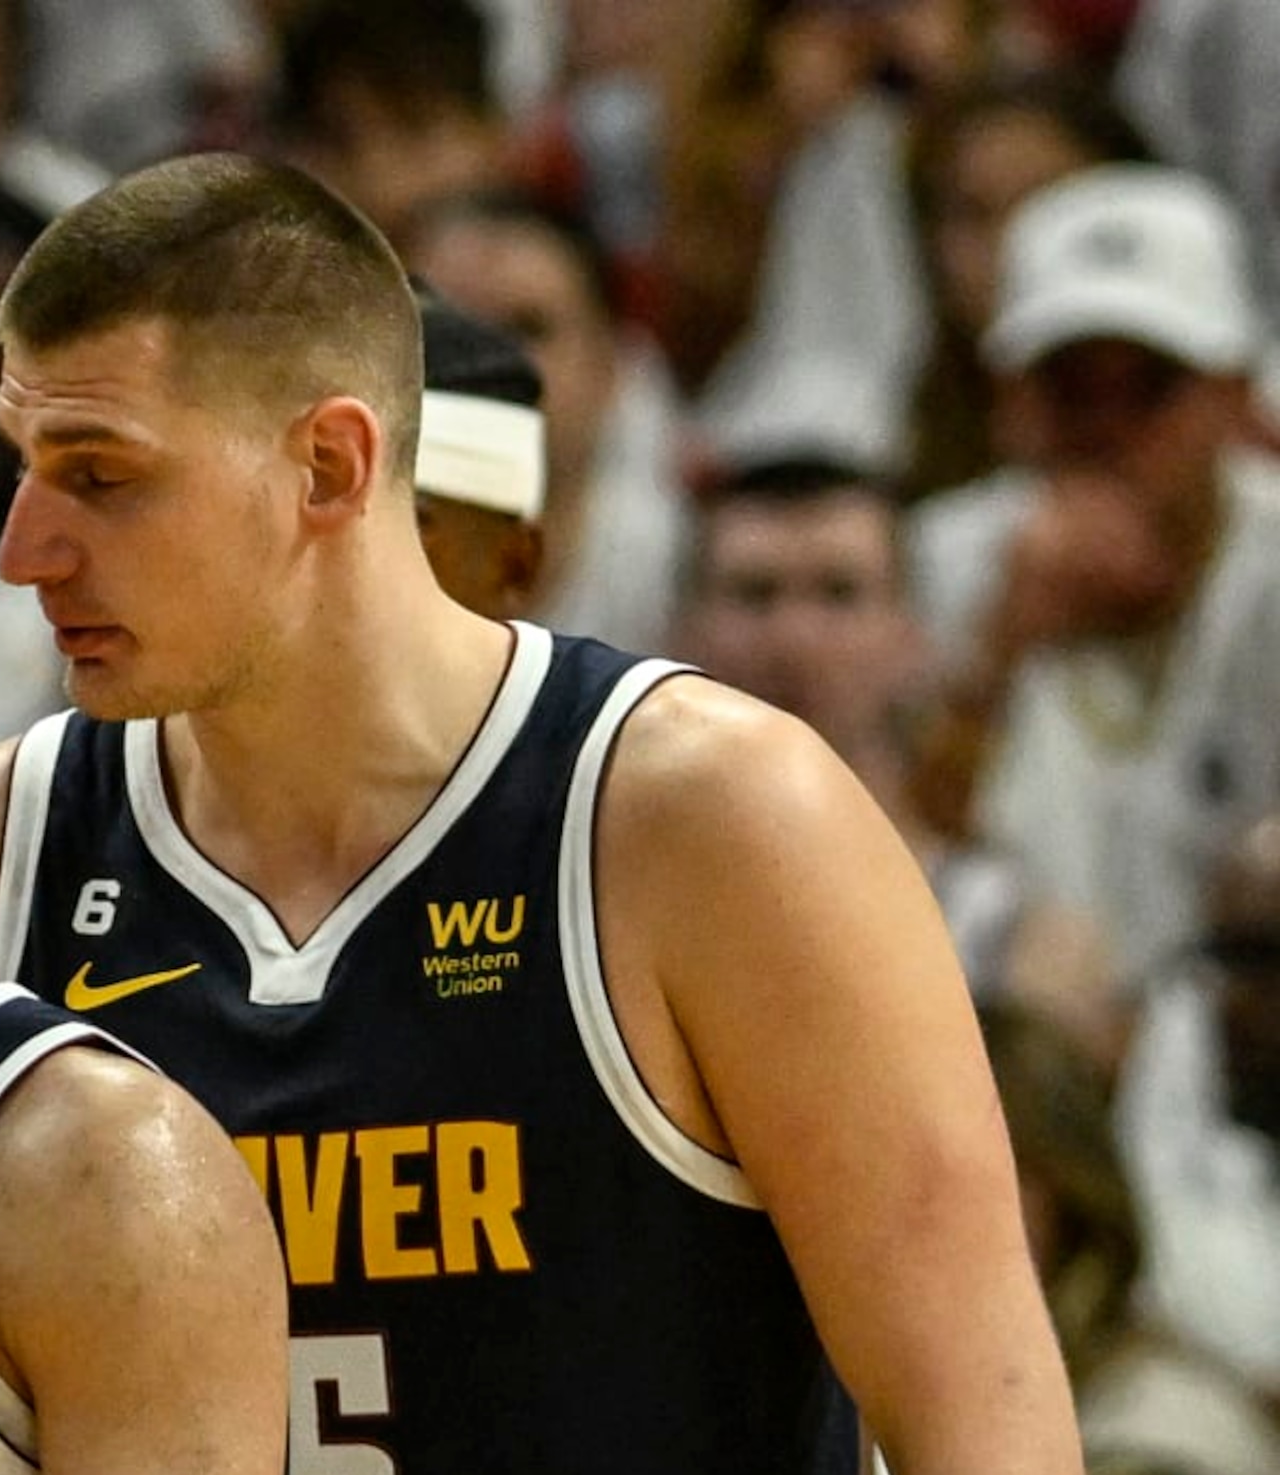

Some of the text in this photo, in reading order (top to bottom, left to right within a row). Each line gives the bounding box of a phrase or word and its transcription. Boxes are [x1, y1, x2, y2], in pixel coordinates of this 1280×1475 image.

[72, 878, 121, 936] 6
[427, 895, 525, 949] WU
[422, 951, 520, 976] Western
[436, 973, 503, 998] Union
